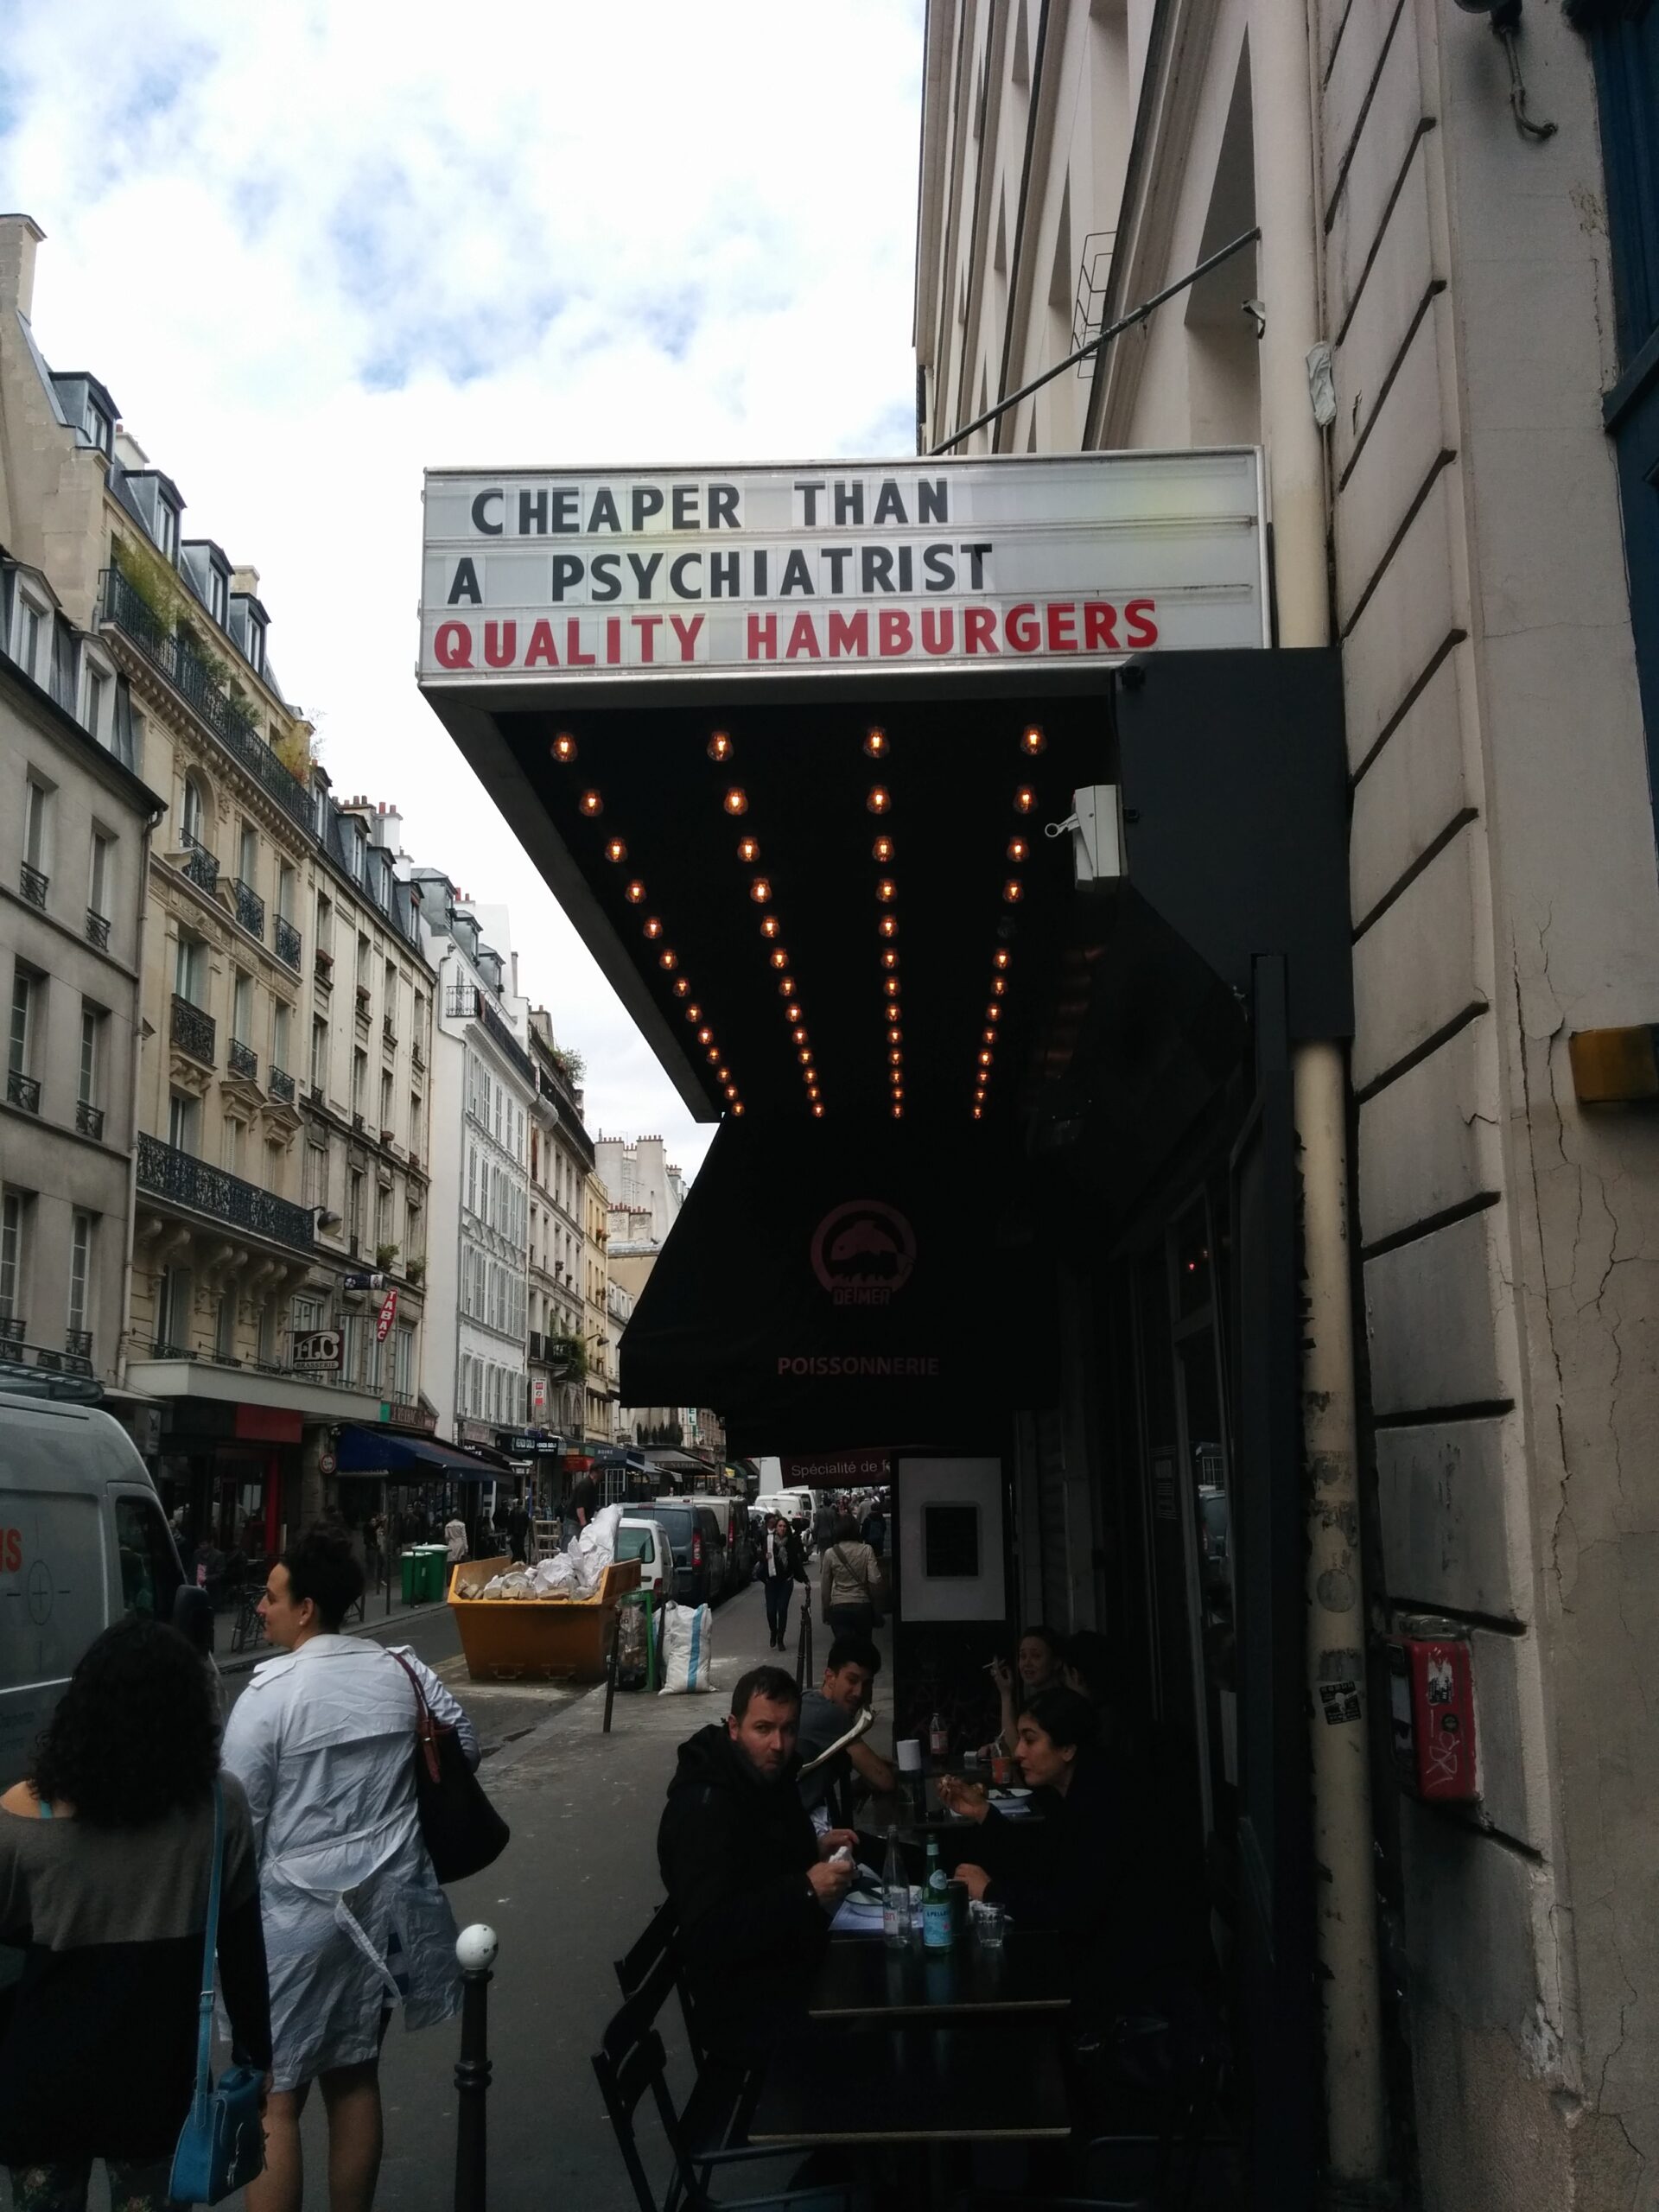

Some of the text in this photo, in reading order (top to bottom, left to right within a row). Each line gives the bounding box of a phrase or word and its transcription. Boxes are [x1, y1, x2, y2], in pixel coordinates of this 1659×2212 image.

[471, 478, 949, 535] CHEAPER THAN
[448, 543, 993, 604] A PSYCHIATRIST
[434, 599, 1158, 669] QUALITY HAMBURGERS
[378, 1290, 397, 1340] TABAC
[777, 1357, 940, 1376] POISSONNERIE
[791, 1460, 856, 1478] Spécialité
[861, 1459, 878, 1472] de
